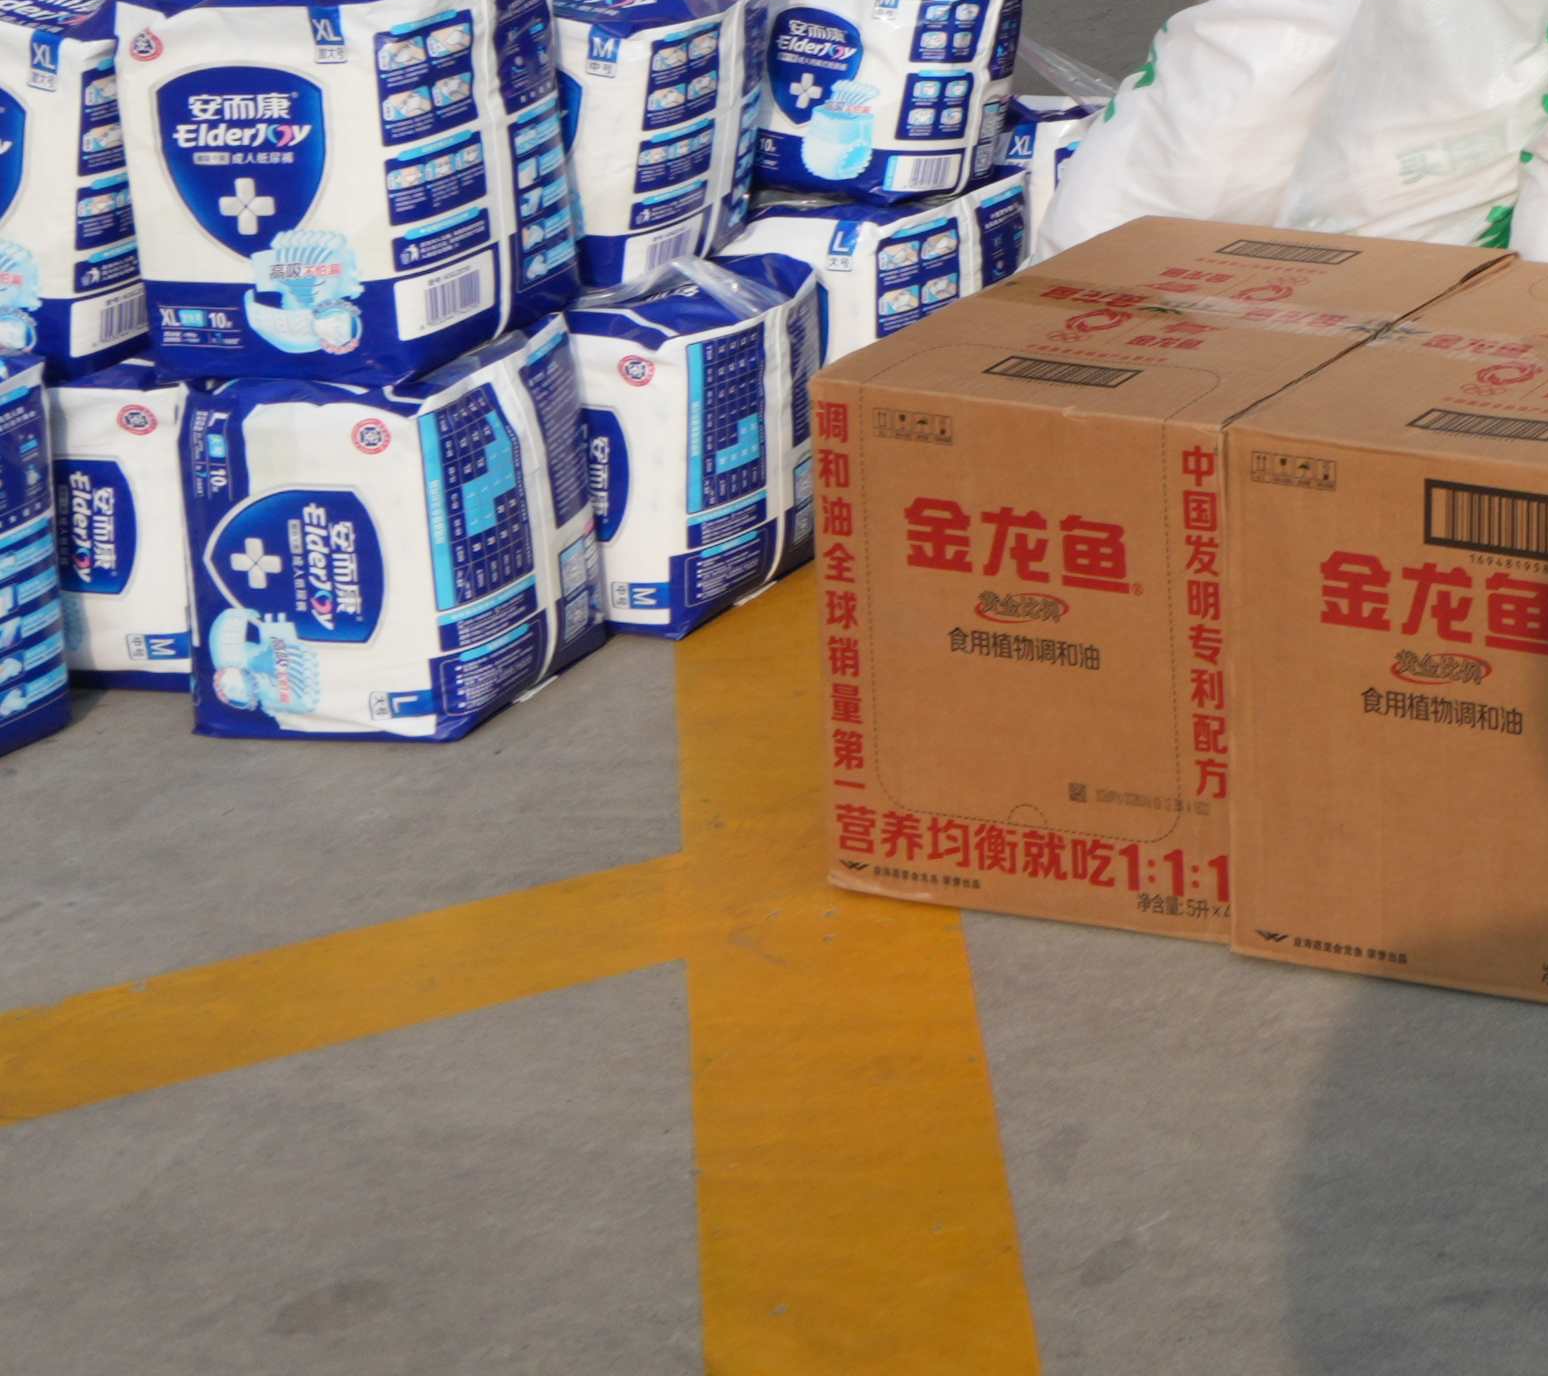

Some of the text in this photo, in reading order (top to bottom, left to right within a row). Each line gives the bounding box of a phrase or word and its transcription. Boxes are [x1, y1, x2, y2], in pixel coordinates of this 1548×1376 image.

[313, 19, 339, 42] XL
[788, 20, 847, 43] 安而康
[33, 44, 56, 69] XL
[591, 38, 615, 59] M
[776, 36, 856, 61] ElderJoy
[188, 93, 292, 121] 安而康
[172, 123, 312, 149] ElderJoy
[1009, 136, 1032, 157] XL
[833, 227, 849, 254] L
[70, 471, 93, 583] ElderJoy
[93, 487, 116, 578] 安而康
[904, 497, 1129, 594] 金龙鱼
[303, 503, 334, 631] ElderJoy
[330, 521, 360, 618] 安而康
[816, 400, 864, 789] 调和油全球销量第一
[1181, 445, 1229, 799] 中国发明专利配方
[150, 636, 176, 658] M
[948, 626, 1101, 671] 食用植物调和油
[390, 693, 416, 715] L
[1359, 687, 1523, 736] 食用植物调和油
[835, 803, 1231, 902] 营养均衡就吃1:1:1
